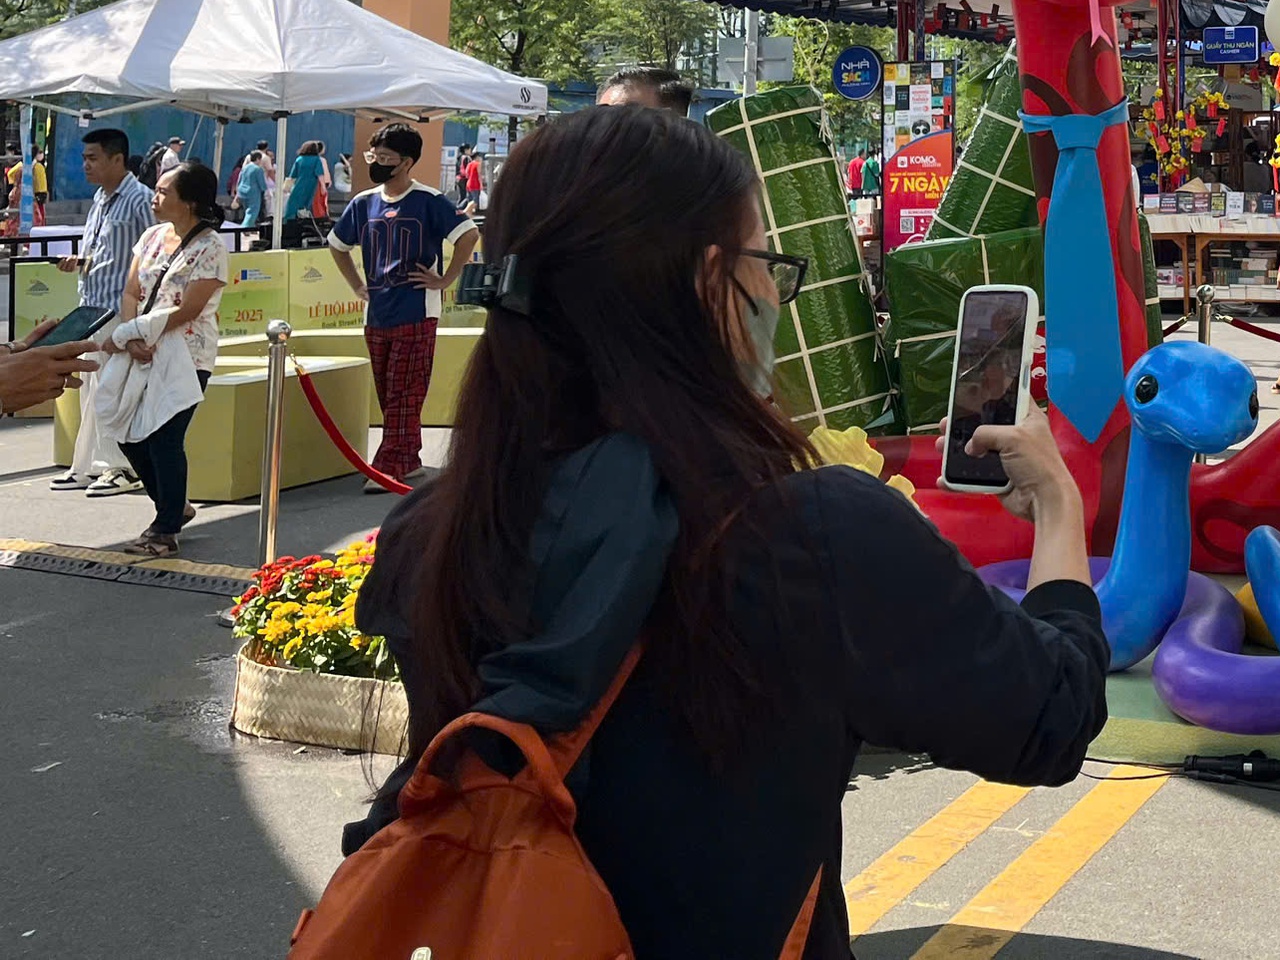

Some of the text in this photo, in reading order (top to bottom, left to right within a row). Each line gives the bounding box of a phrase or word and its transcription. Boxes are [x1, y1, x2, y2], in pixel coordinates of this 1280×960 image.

[841, 58, 870, 71] NHÀ
[909, 155, 936, 164] KOMO
[890, 177, 899, 192] 7
[234, 309, 263, 322] 2025
